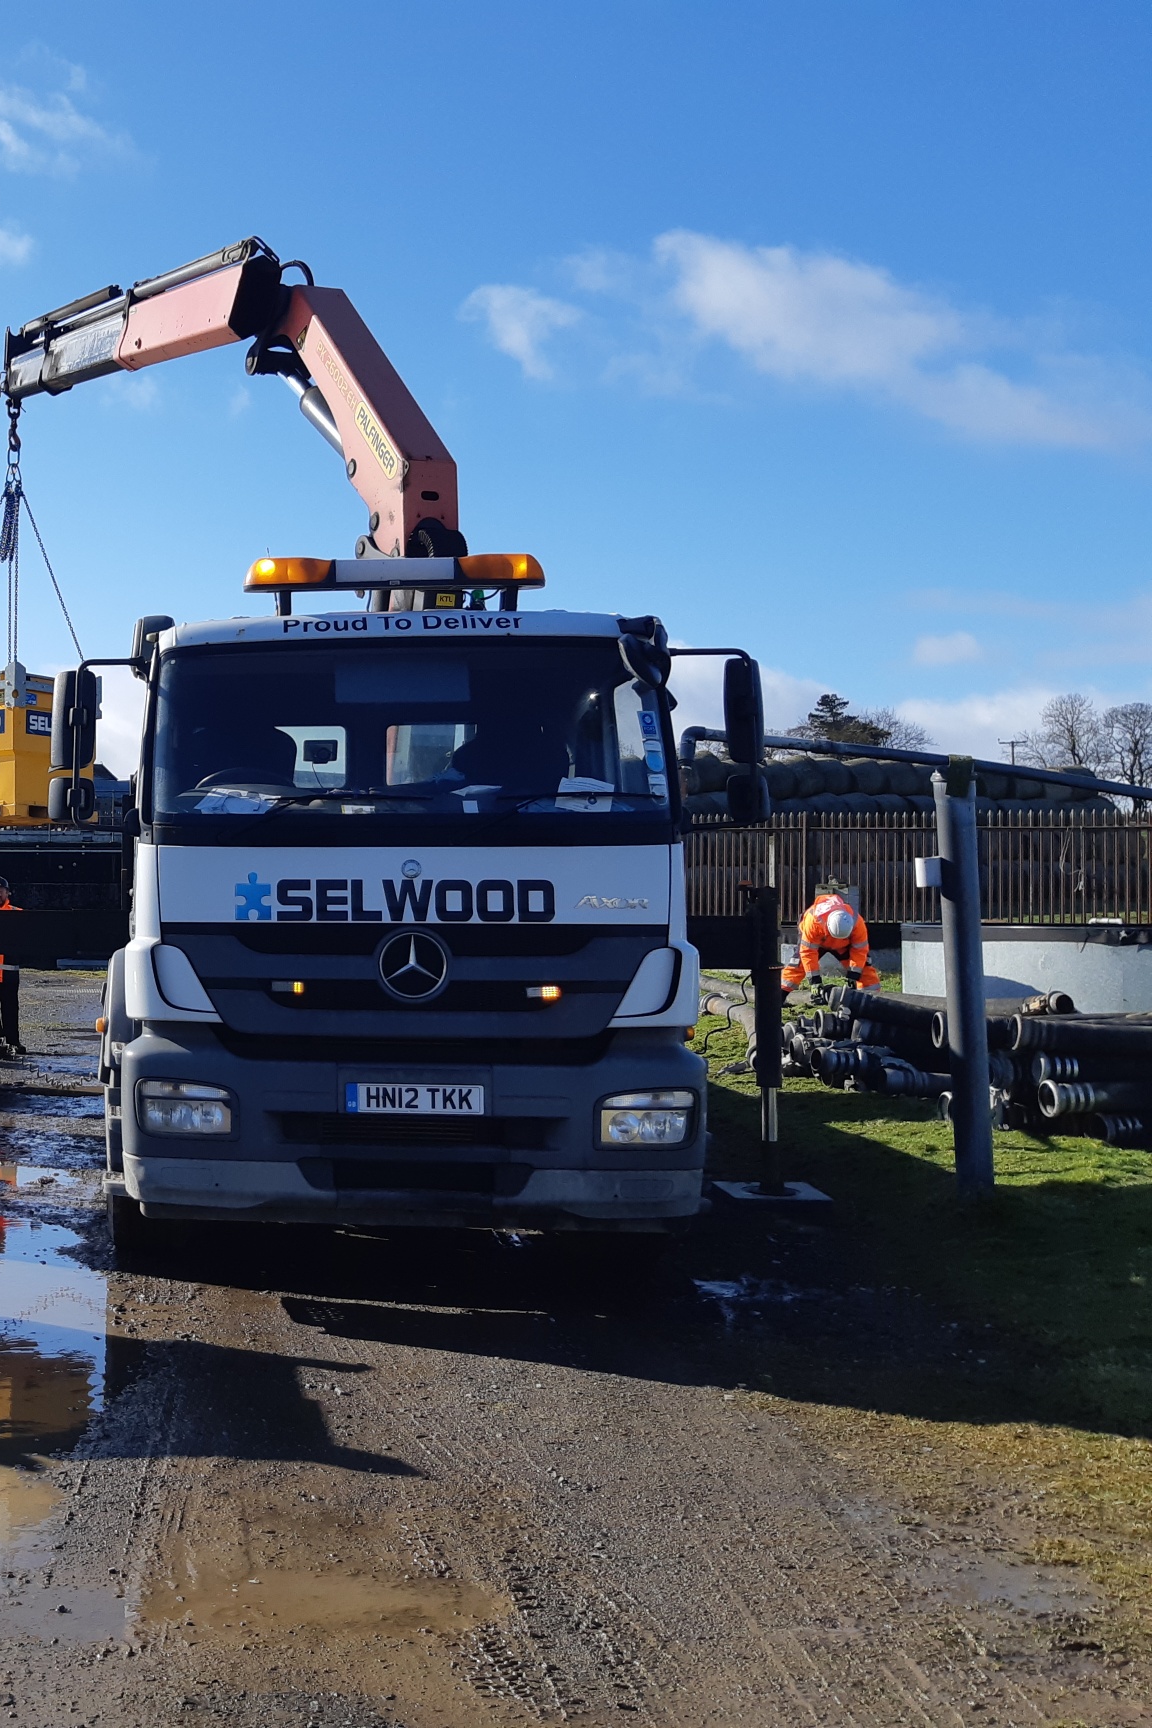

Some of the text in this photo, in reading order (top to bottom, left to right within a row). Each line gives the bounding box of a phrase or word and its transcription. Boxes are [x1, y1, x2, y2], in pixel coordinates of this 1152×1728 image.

[316, 342, 327, 361] PK
[325, 355, 348, 395] 26002
[357, 406, 395, 474] PALFINGER
[439, 595, 453, 603] KTL
[283, 614, 522, 633] Proud To Deliver
[276, 879, 556, 923] SELWOOD
[574, 895, 648, 909] AXOR
[366, 1086, 473, 1110] HN12 TKK
